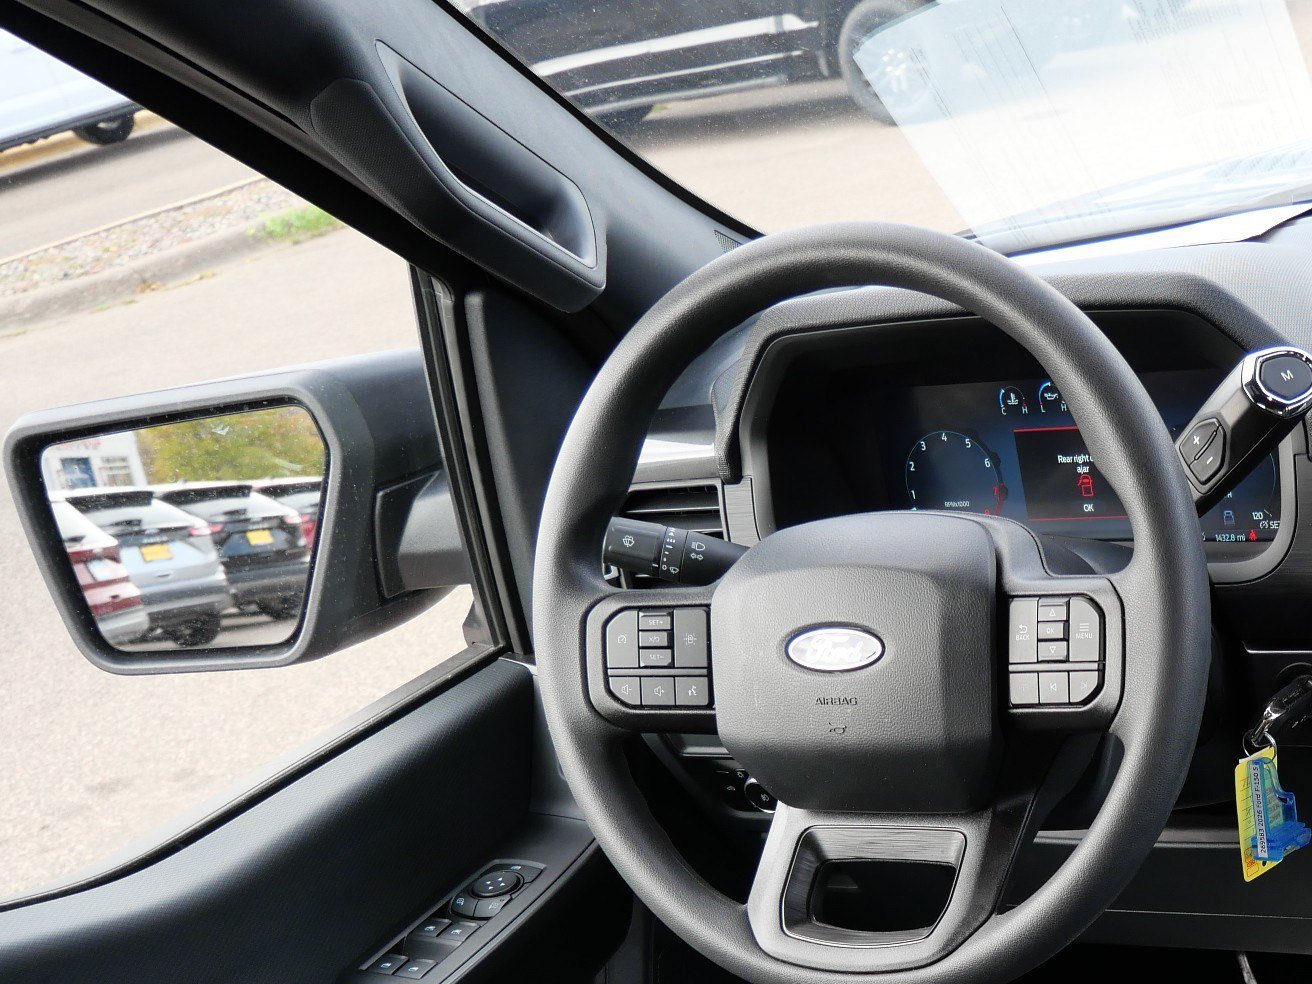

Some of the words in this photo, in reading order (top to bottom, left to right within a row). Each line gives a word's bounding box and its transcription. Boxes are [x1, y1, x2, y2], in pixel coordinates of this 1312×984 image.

[1281, 370, 1294, 382] M
[1001, 407, 1007, 415] C
[1022, 405, 1029, 414] H
[1040, 405, 1046, 413] L
[941, 432, 948, 442] 4
[920, 441, 927, 451] 3
[965, 438, 972, 448] 5
[984, 458, 991, 468] 6
[1057, 455, 1073, 464] Rear
[1074, 454, 1089, 464] right
[909, 461, 916, 471] 2
[1076, 465, 1090, 474] ajar
[911, 490, 916, 500] 1
[1083, 503, 1094, 512] OK
[1252, 511, 1264, 520] 120
[1236, 533, 1246, 542] mi
[815, 697, 858, 706] AIRBAG
